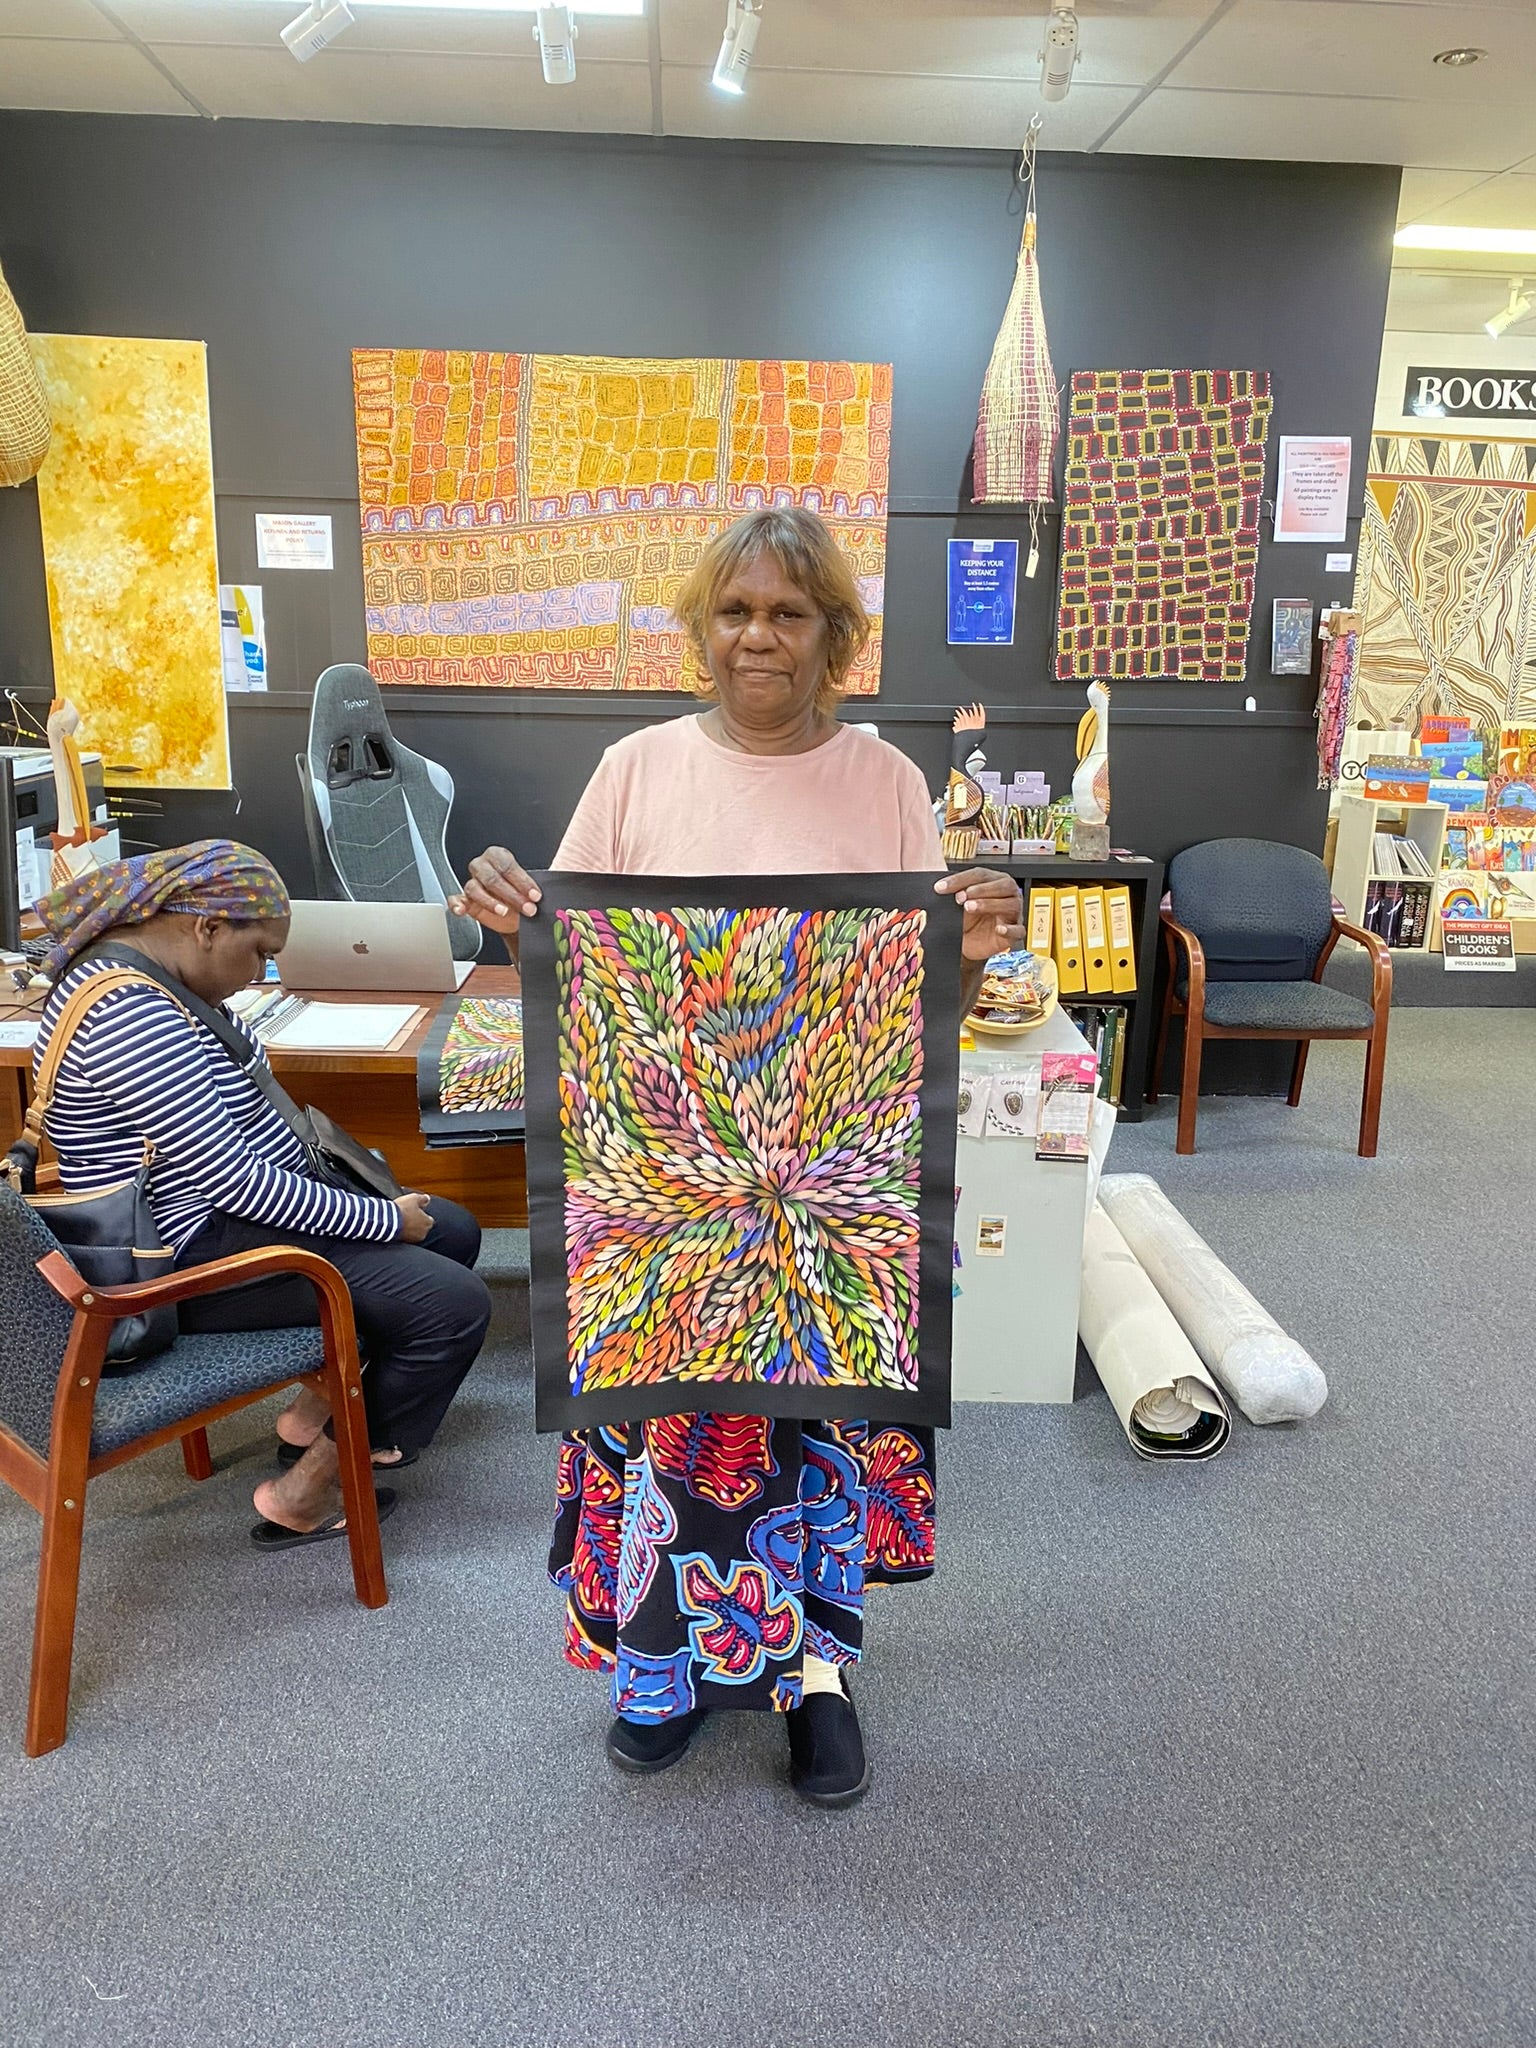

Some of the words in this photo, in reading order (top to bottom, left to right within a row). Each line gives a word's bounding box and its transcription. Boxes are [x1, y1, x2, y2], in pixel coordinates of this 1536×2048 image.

[1434, 745, 1452, 753] Sydney
[1446, 934, 1510, 945] CHILDREN'S
[1460, 945, 1498, 954] BOOKS
